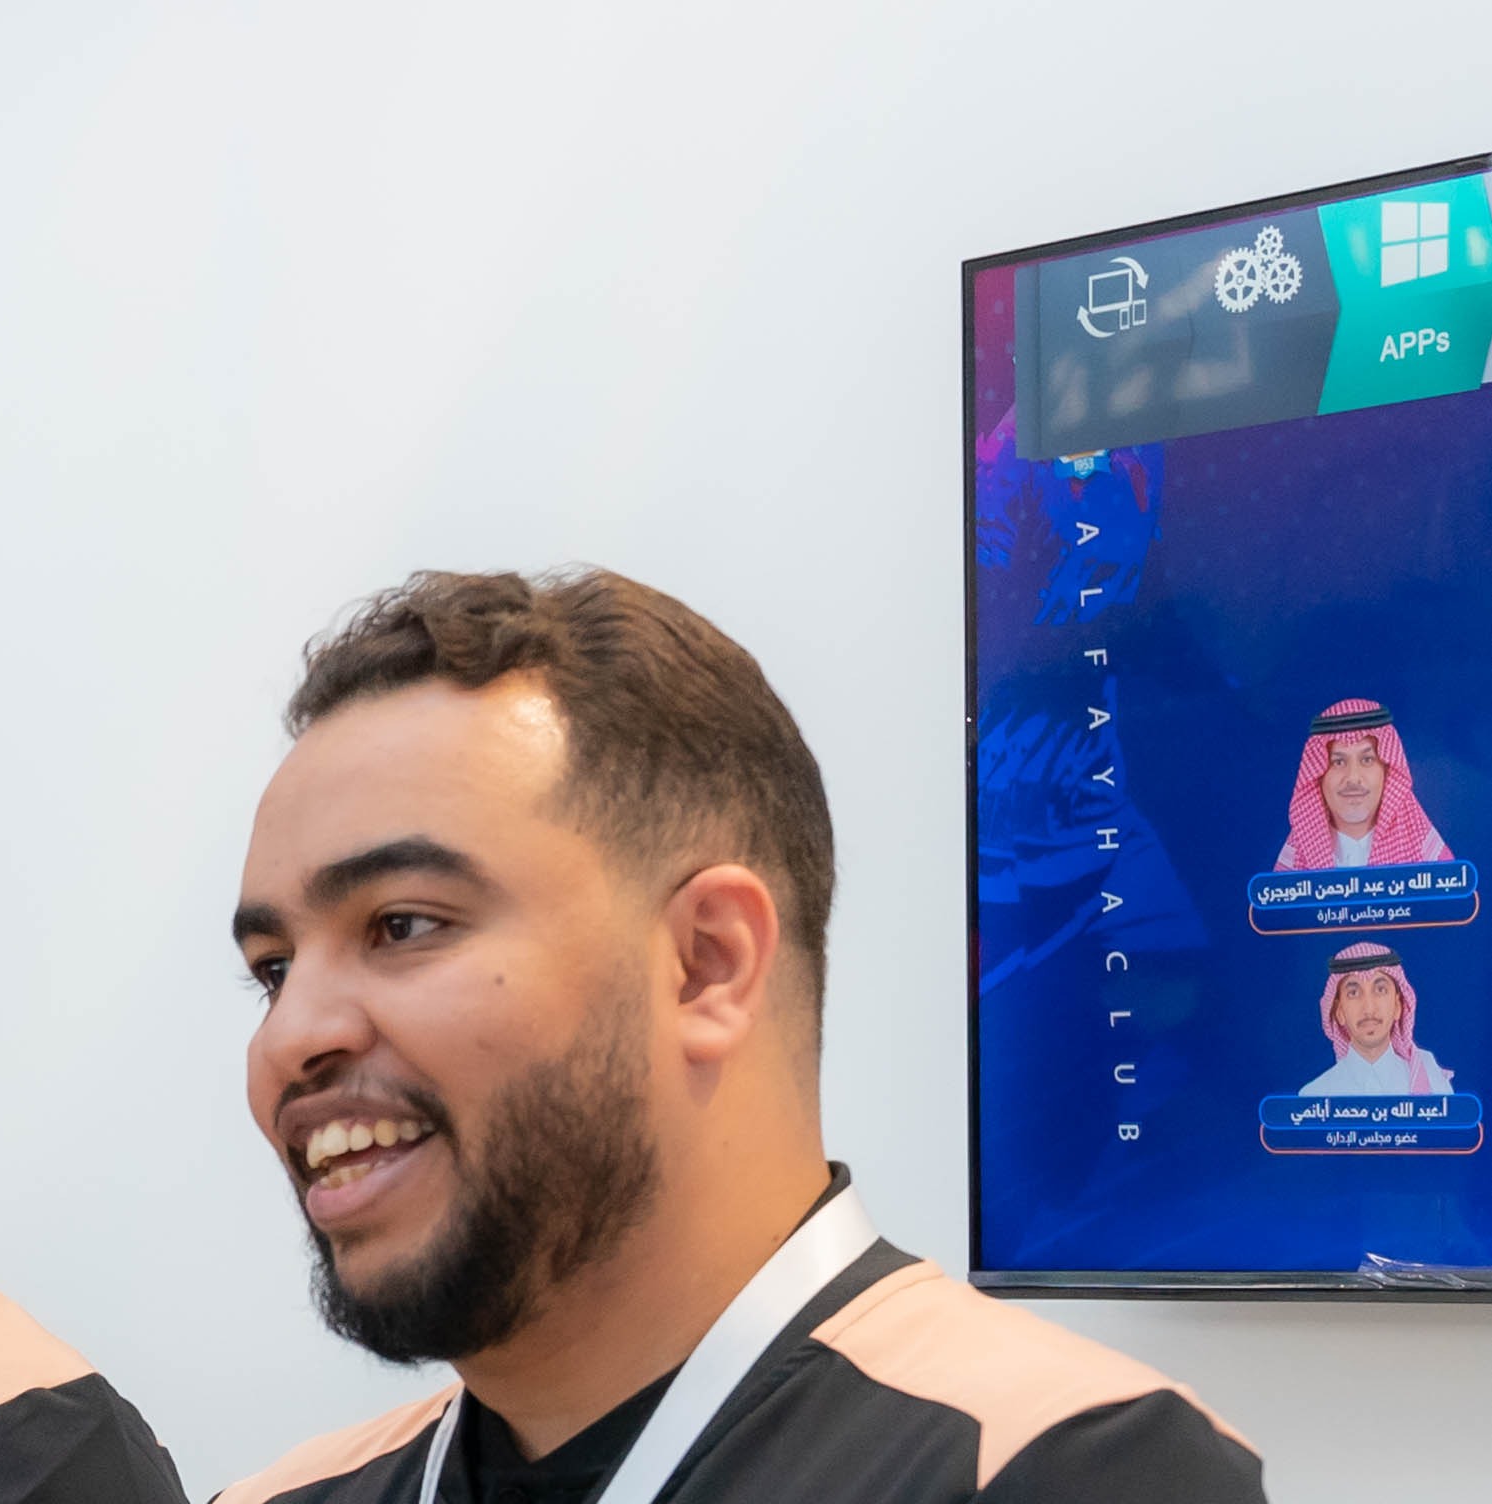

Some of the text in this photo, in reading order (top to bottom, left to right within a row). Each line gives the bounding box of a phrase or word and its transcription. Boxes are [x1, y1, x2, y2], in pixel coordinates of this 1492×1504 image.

[1379, 327, 1451, 362] APPs
[1314, 877, 1360, 900] الرحمن
[1362, 878, 1386, 897] عبد
[1387, 879, 1405, 895] بن
[1407, 873, 1432, 890] الله
[1256, 880, 1313, 906] التويجري
[1350, 905, 1385, 923] مجلس
[1387, 905, 1412, 921] عضو
[1104, 950, 1140, 1143] CLUB
[1332, 1106, 1369, 1119] محمد
[1371, 1105, 1388, 1122] بن
[1390, 1102, 1414, 1119] الله
[1358, 1130, 1392, 1146] مجلس
[1394, 1131, 1419, 1146] عضو
